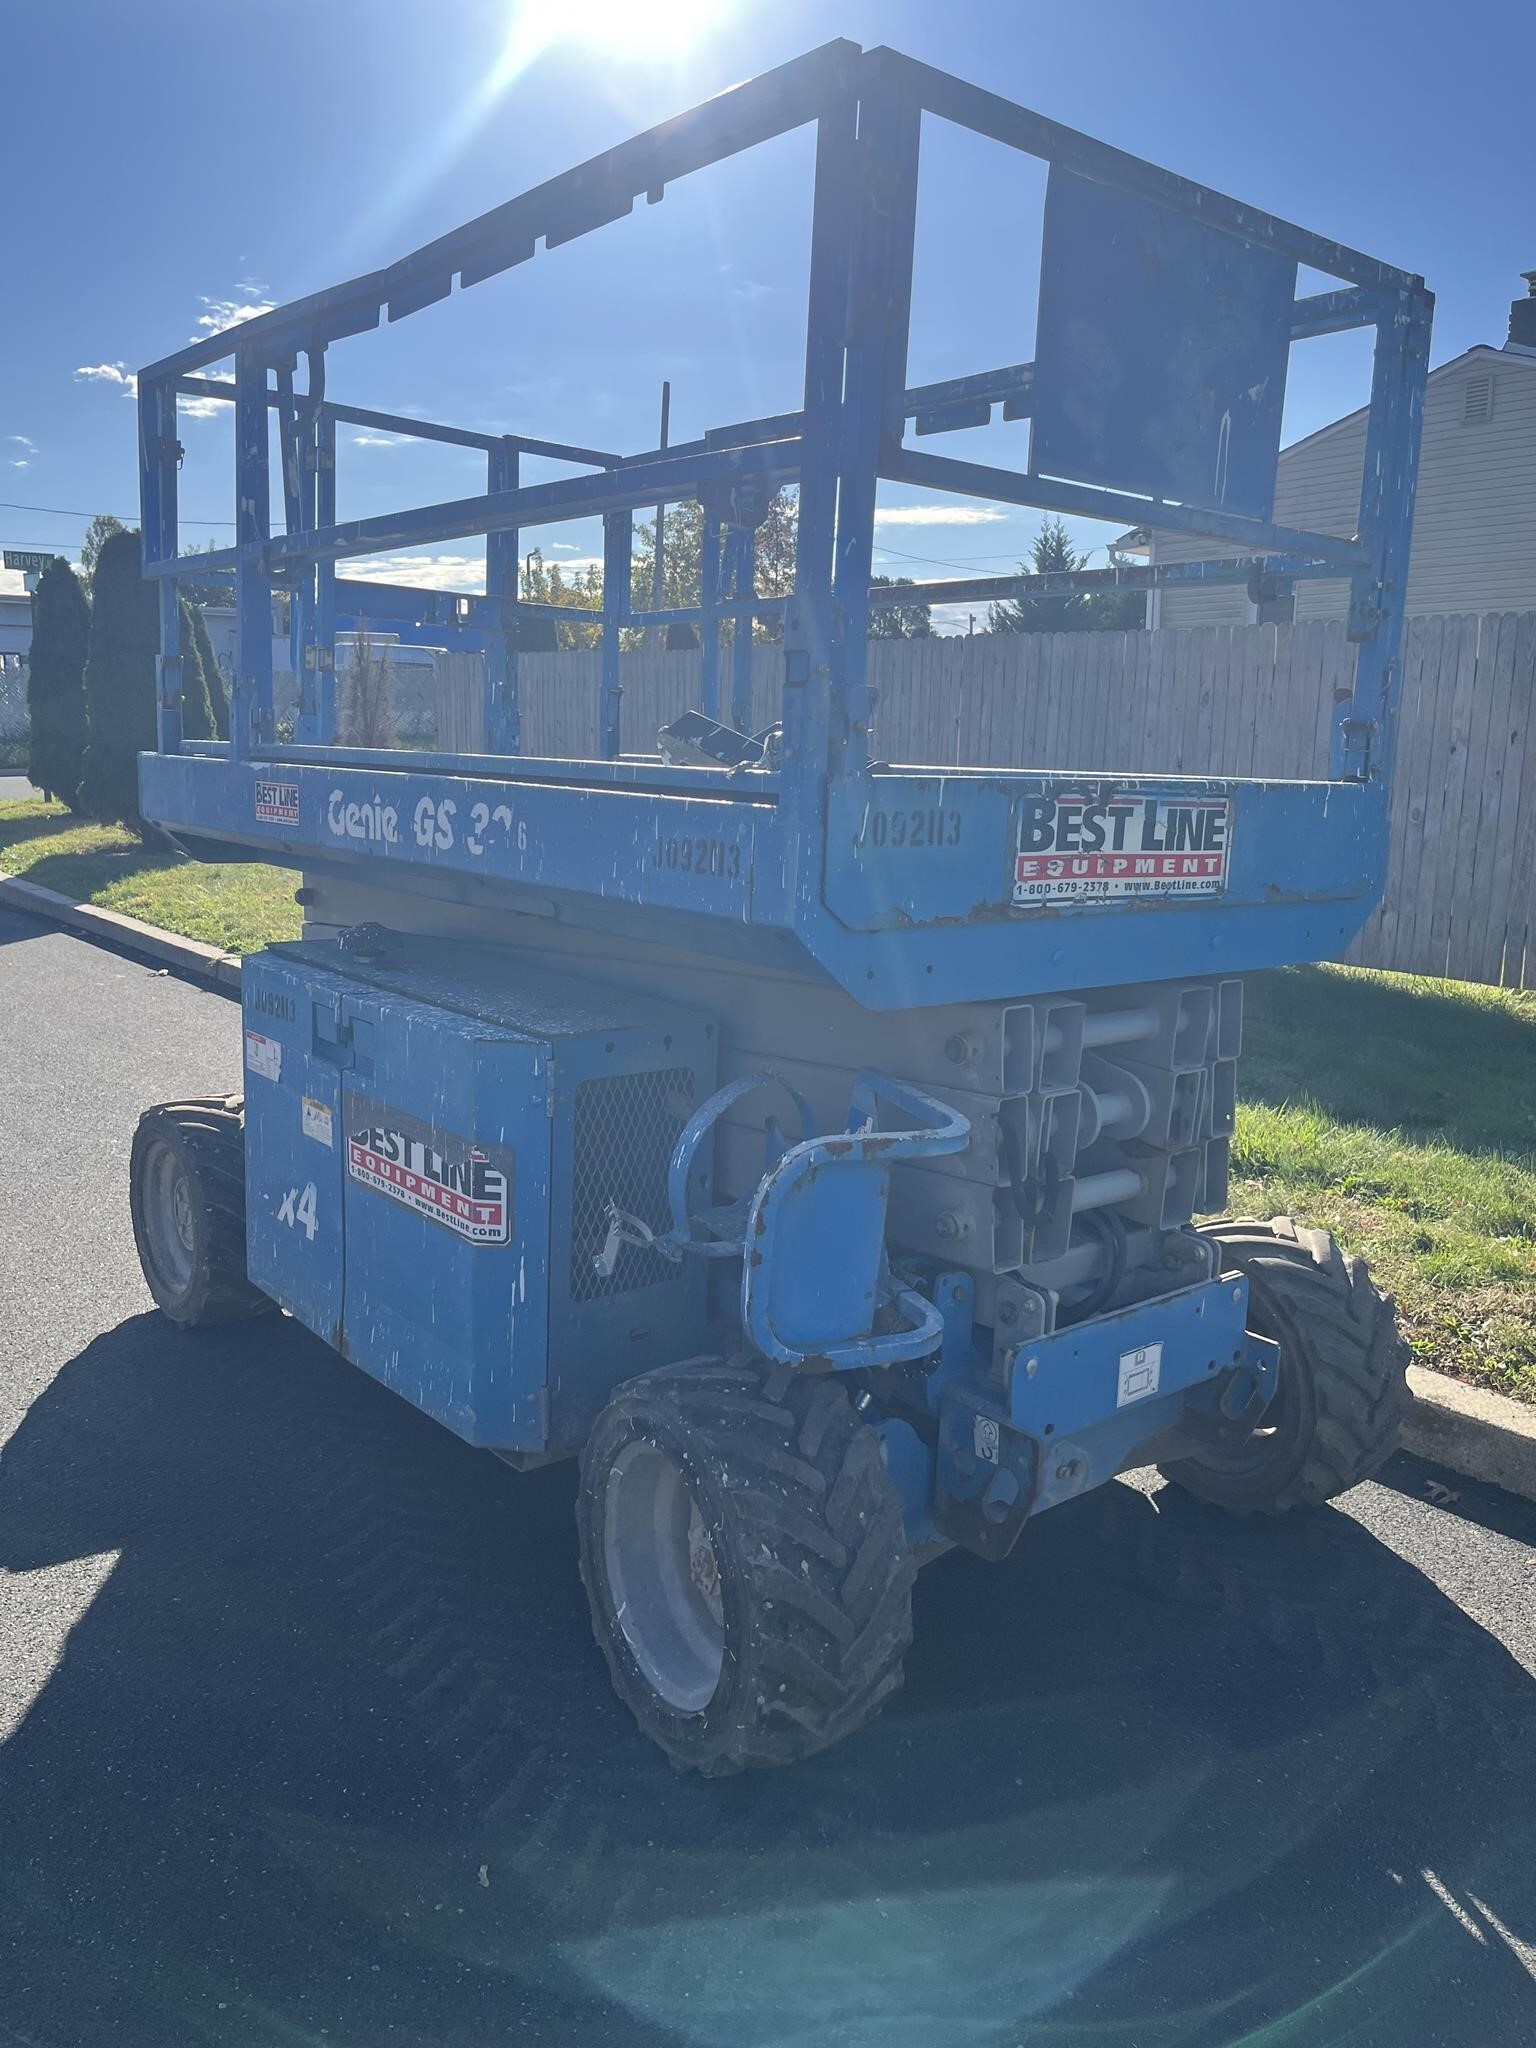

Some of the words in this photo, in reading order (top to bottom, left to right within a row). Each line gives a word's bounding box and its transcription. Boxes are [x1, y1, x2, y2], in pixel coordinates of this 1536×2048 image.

[5, 551, 45, 570] Harvey
[256, 782, 278, 804] BEST
[279, 784, 298, 807] LINE
[328, 789, 399, 842] Genie
[413, 796, 457, 850] GS
[1019, 797, 1134, 852] BEST
[1141, 798, 1226, 851] LINE
[1023, 857, 1218, 877] EQUIPMENT
[1016, 881, 1109, 895] 1-800-679-2378
[353, 1148, 495, 1224] EQUIPMENT
[415, 1197, 501, 1237] www.BestLine.com
